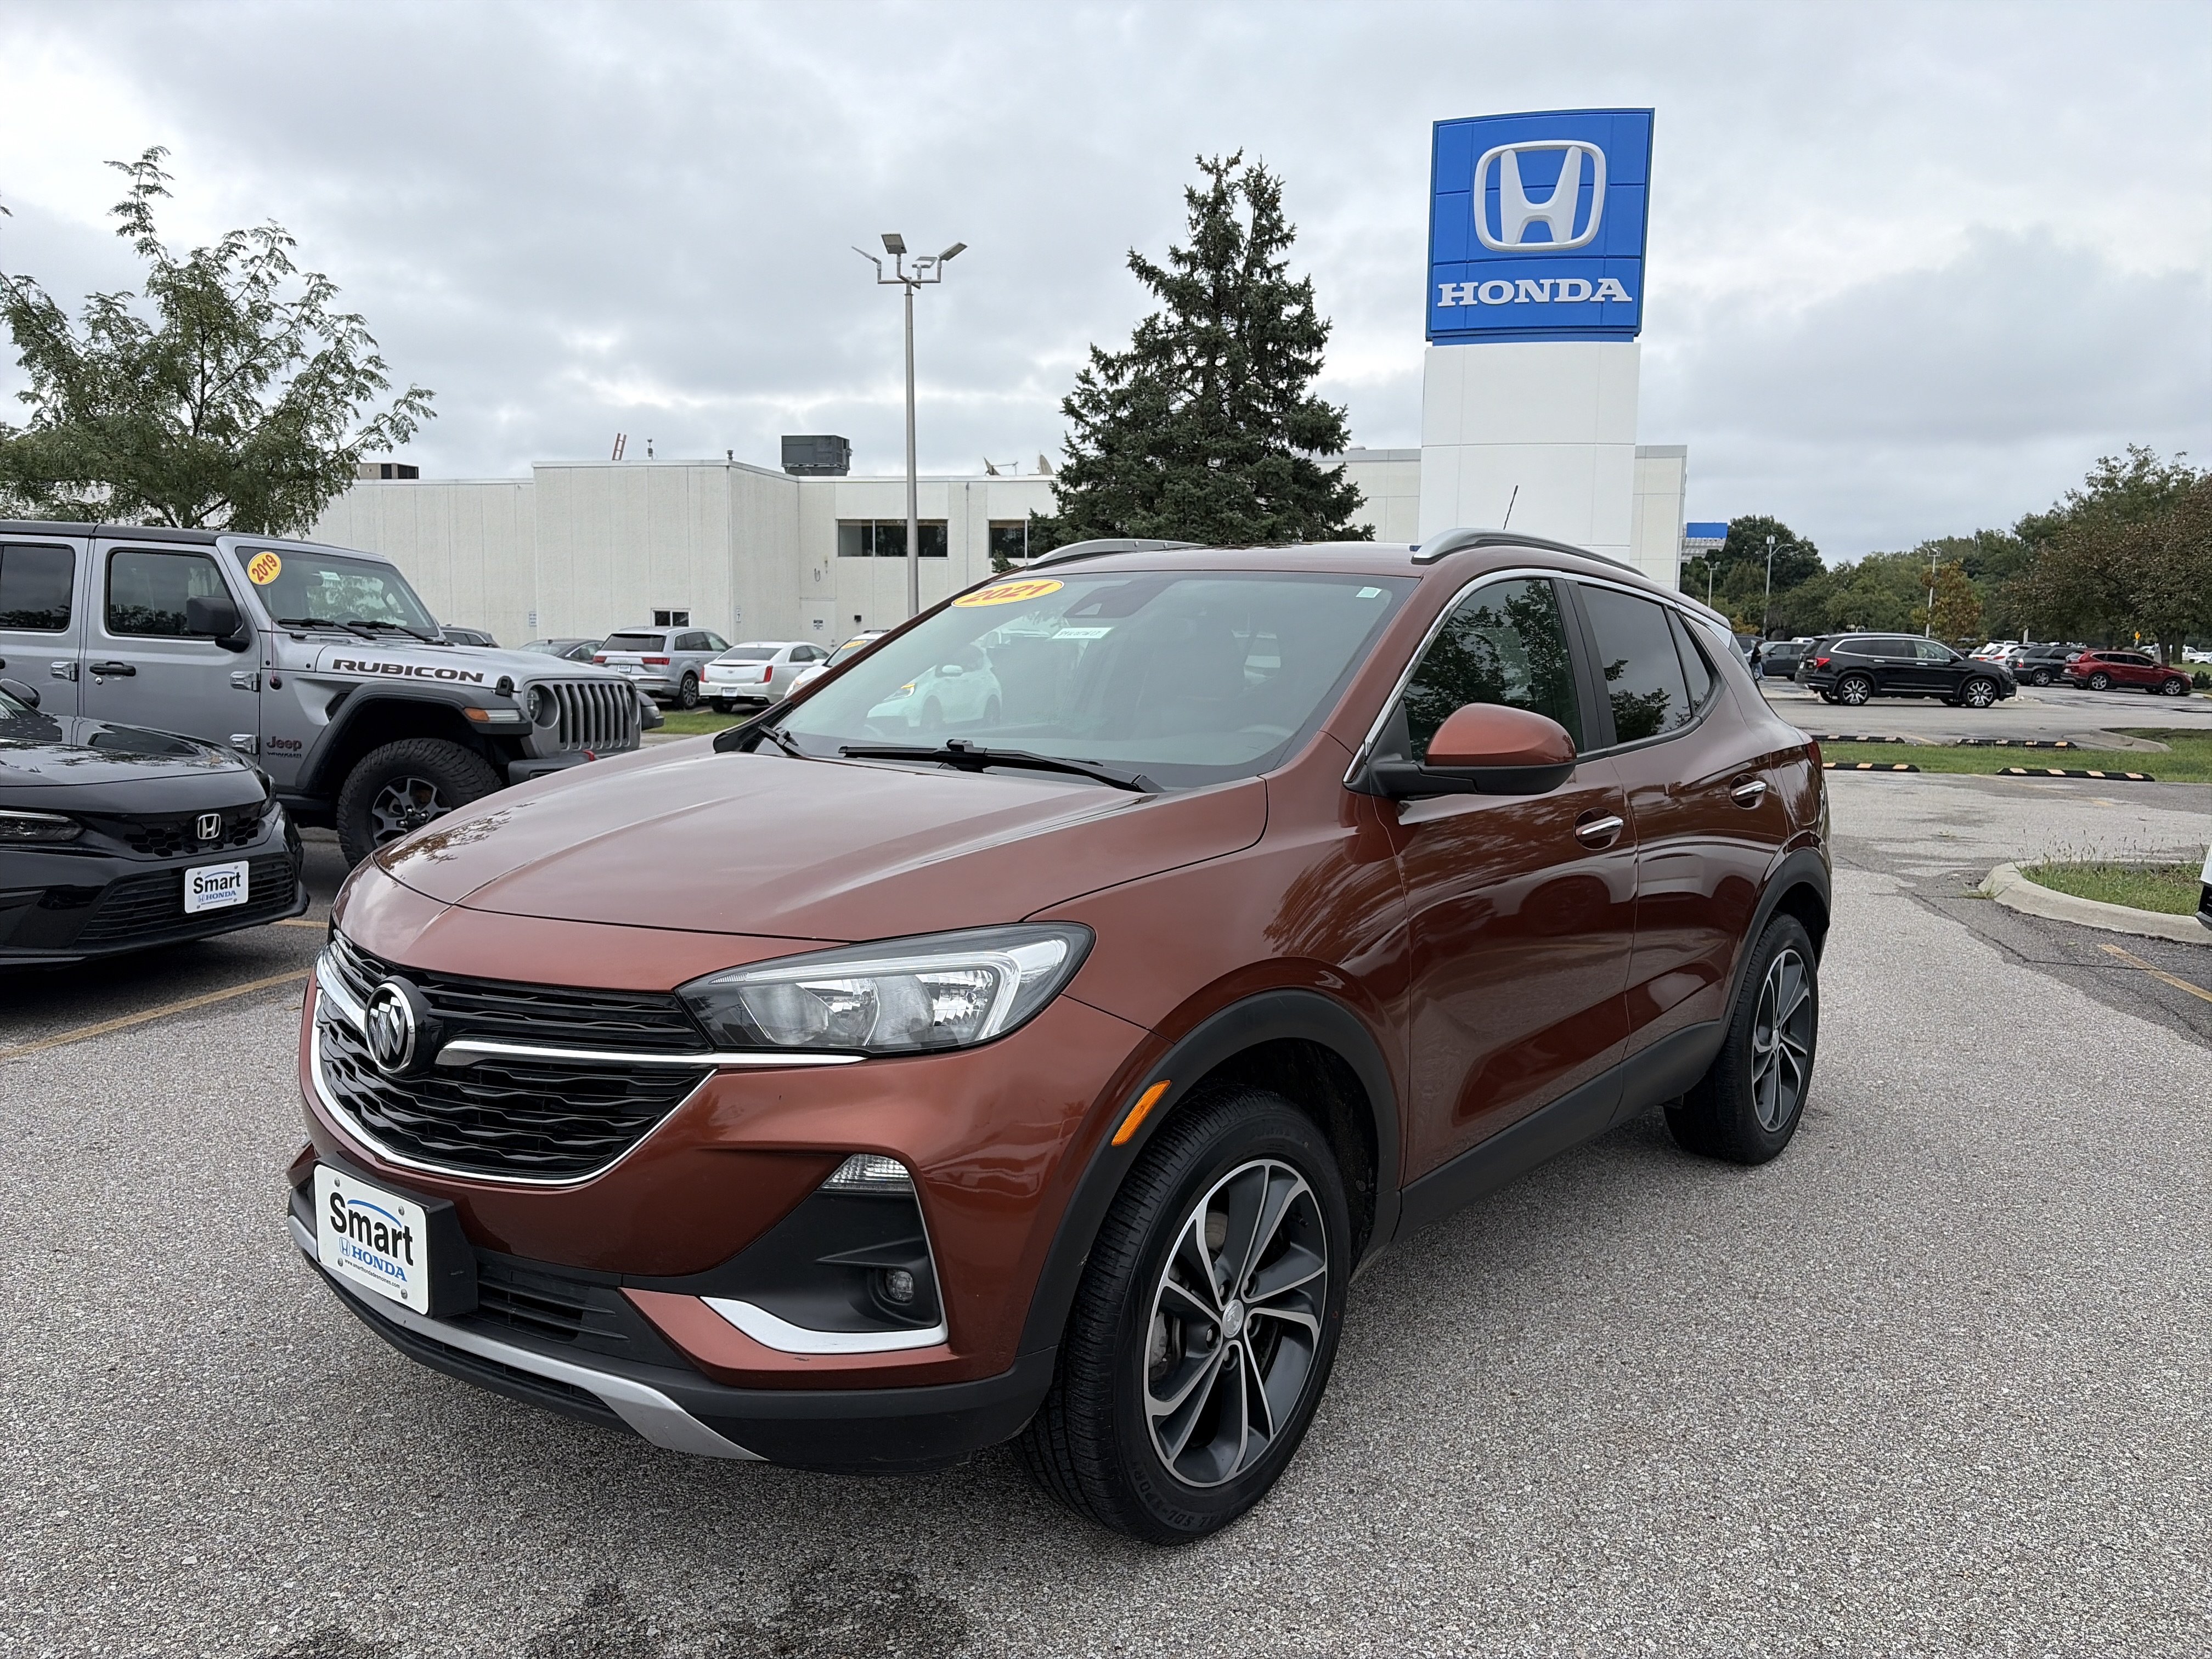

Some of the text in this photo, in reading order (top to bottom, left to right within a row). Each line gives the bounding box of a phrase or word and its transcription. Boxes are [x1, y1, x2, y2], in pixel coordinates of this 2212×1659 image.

[1437, 278, 1633, 307] HONDA
[251, 554, 278, 582] 2019
[958, 582, 1055, 605] 2021
[332, 659, 484, 683] RUBICON
[266, 736, 302, 752] Jeep
[193, 871, 241, 894] Smart
[205, 890, 236, 901] HONDA
[330, 1192, 414, 1266] Smart
[351, 1244, 408, 1283] HONDA
